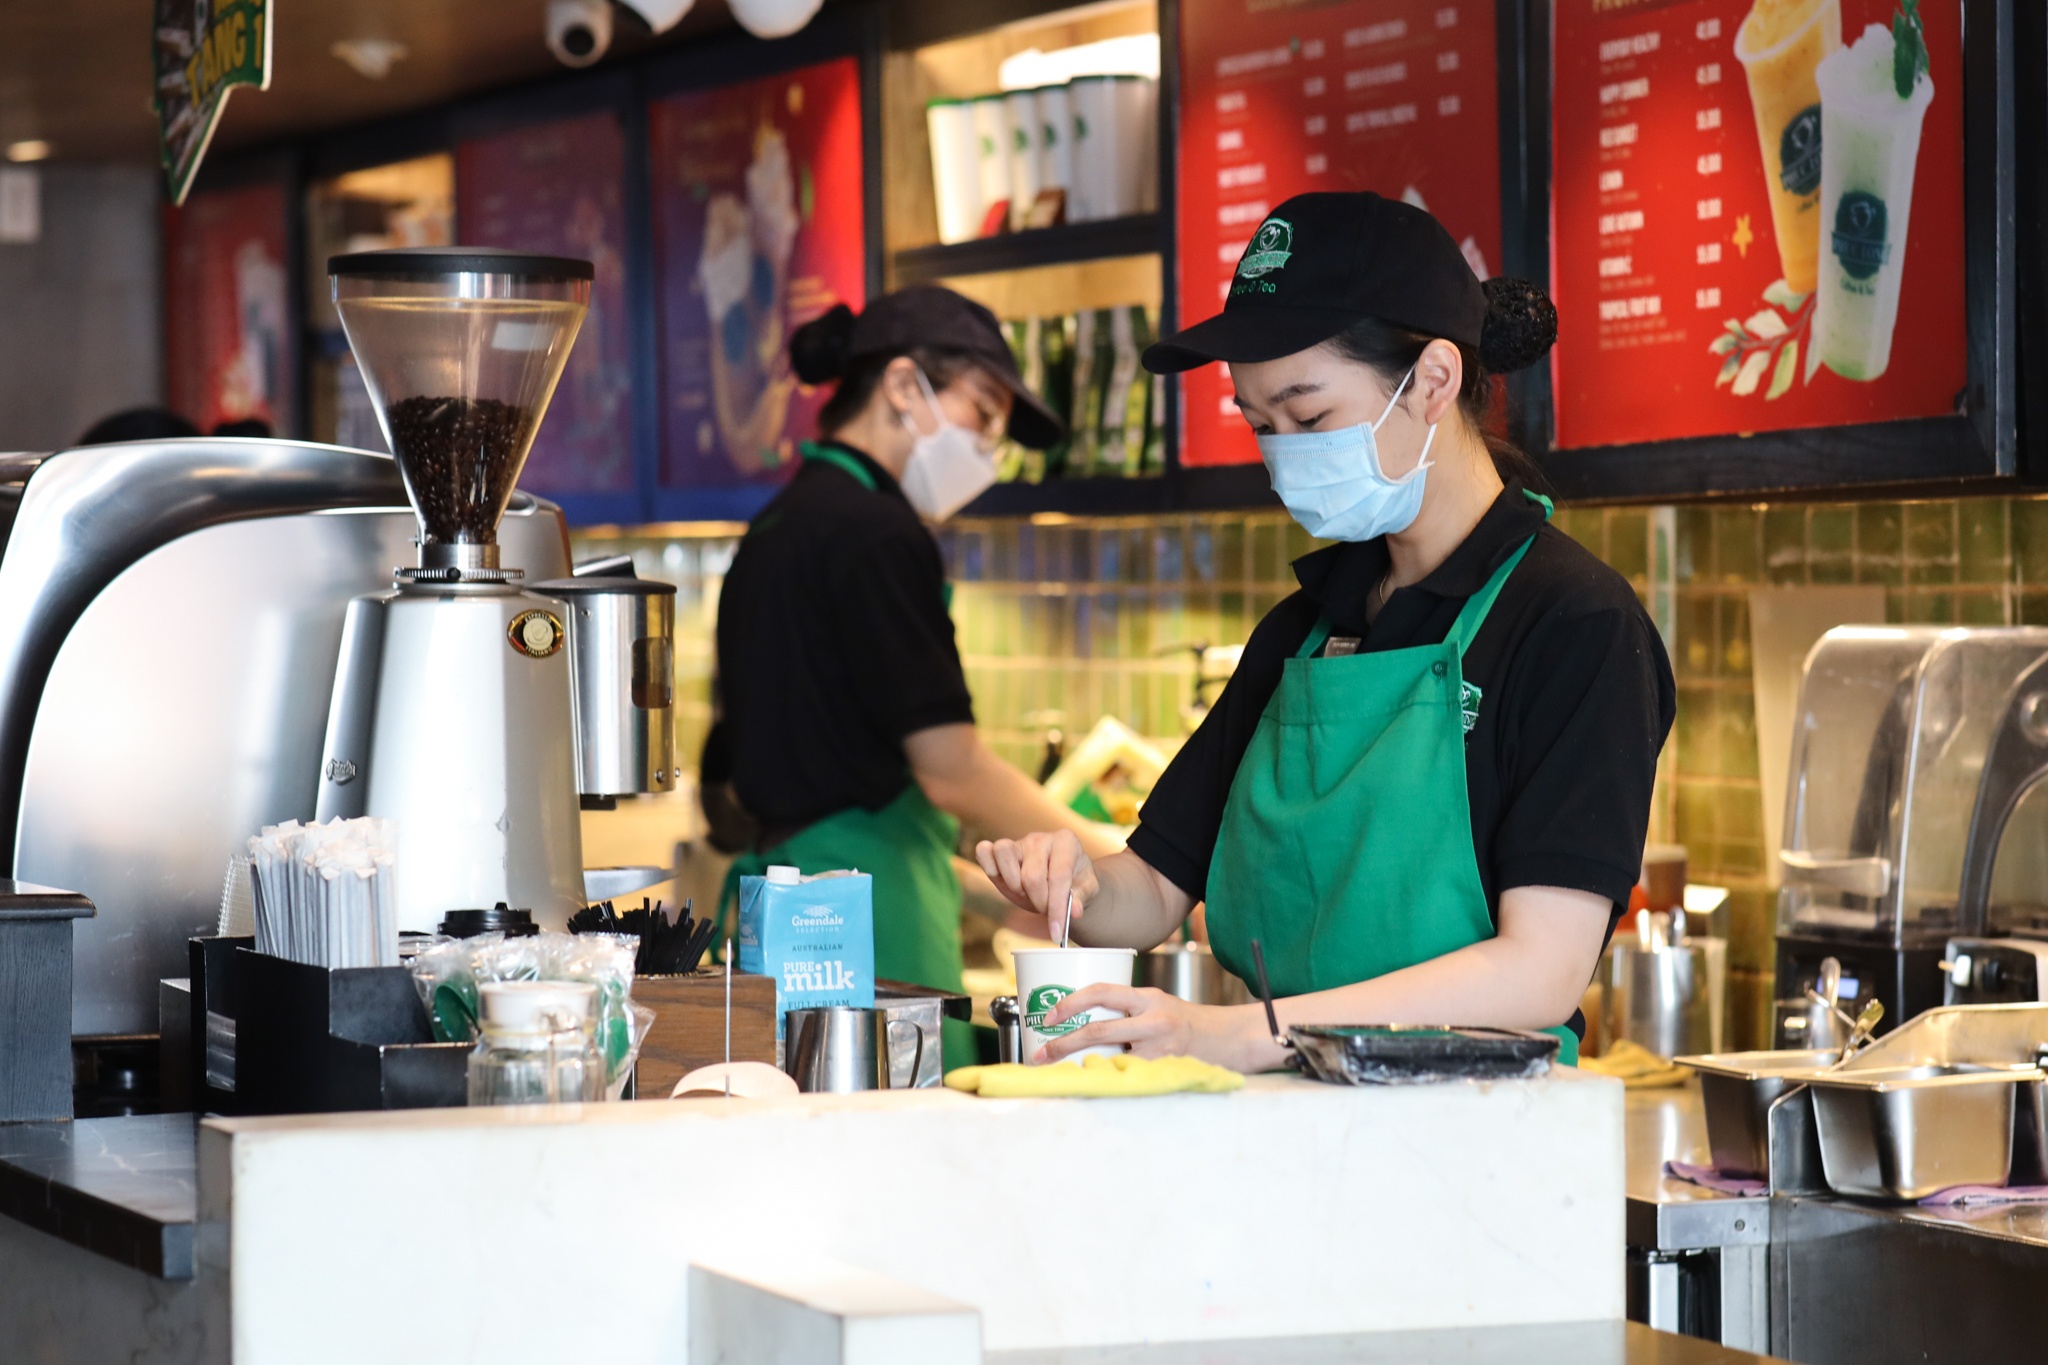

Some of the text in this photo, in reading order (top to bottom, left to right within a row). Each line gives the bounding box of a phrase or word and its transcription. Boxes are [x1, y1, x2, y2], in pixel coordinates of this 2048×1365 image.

[525, 612, 551, 623] ESPRESSO
[526, 645, 553, 657] ITALIANO
[791, 914, 844, 927] Greendale
[796, 926, 839, 934] SELECTION
[792, 943, 843, 952] AUSTRALIAN
[783, 961, 815, 973] PURE
[783, 960, 855, 992] milk
[788, 999, 850, 1009] FULL CREAM
[1026, 1014, 1044, 1026] PHU
